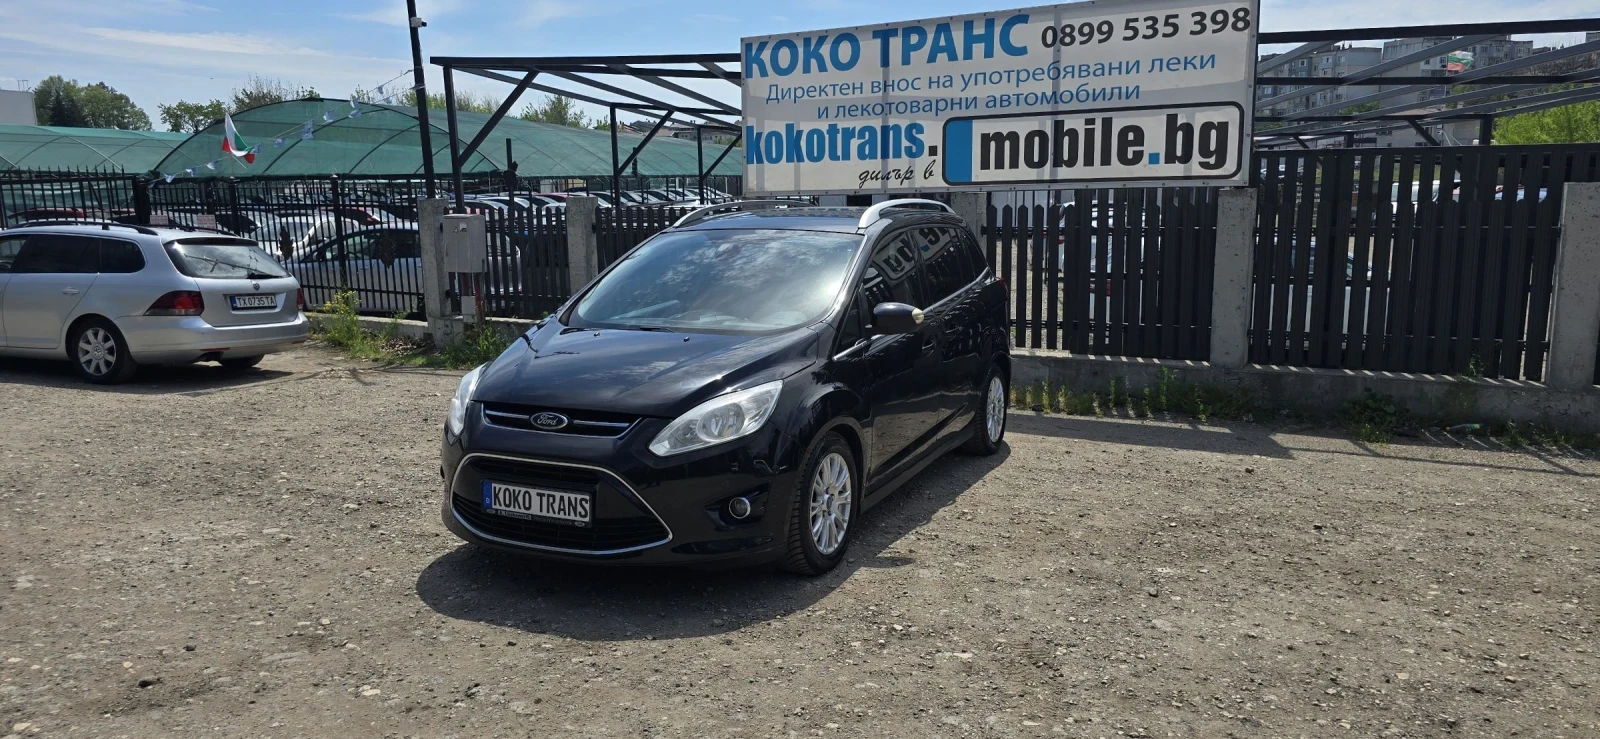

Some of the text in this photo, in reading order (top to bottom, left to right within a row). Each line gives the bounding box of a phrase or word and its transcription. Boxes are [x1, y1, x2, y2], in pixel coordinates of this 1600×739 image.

[744, 14, 1030, 79] КОКО ТРАНС
[1041, 7, 1251, 48] 0899 535 398
[765, 53, 1216, 104] Директен внос на употребявани леки
[817, 82, 1140, 119] и лекотоварни автомобили
[979, 113, 1230, 170] mobile.bg
[858, 159, 936, 188] дилър в
[537, 414, 559, 426] Ford
[493, 486, 589, 518] KOKO TRANS
